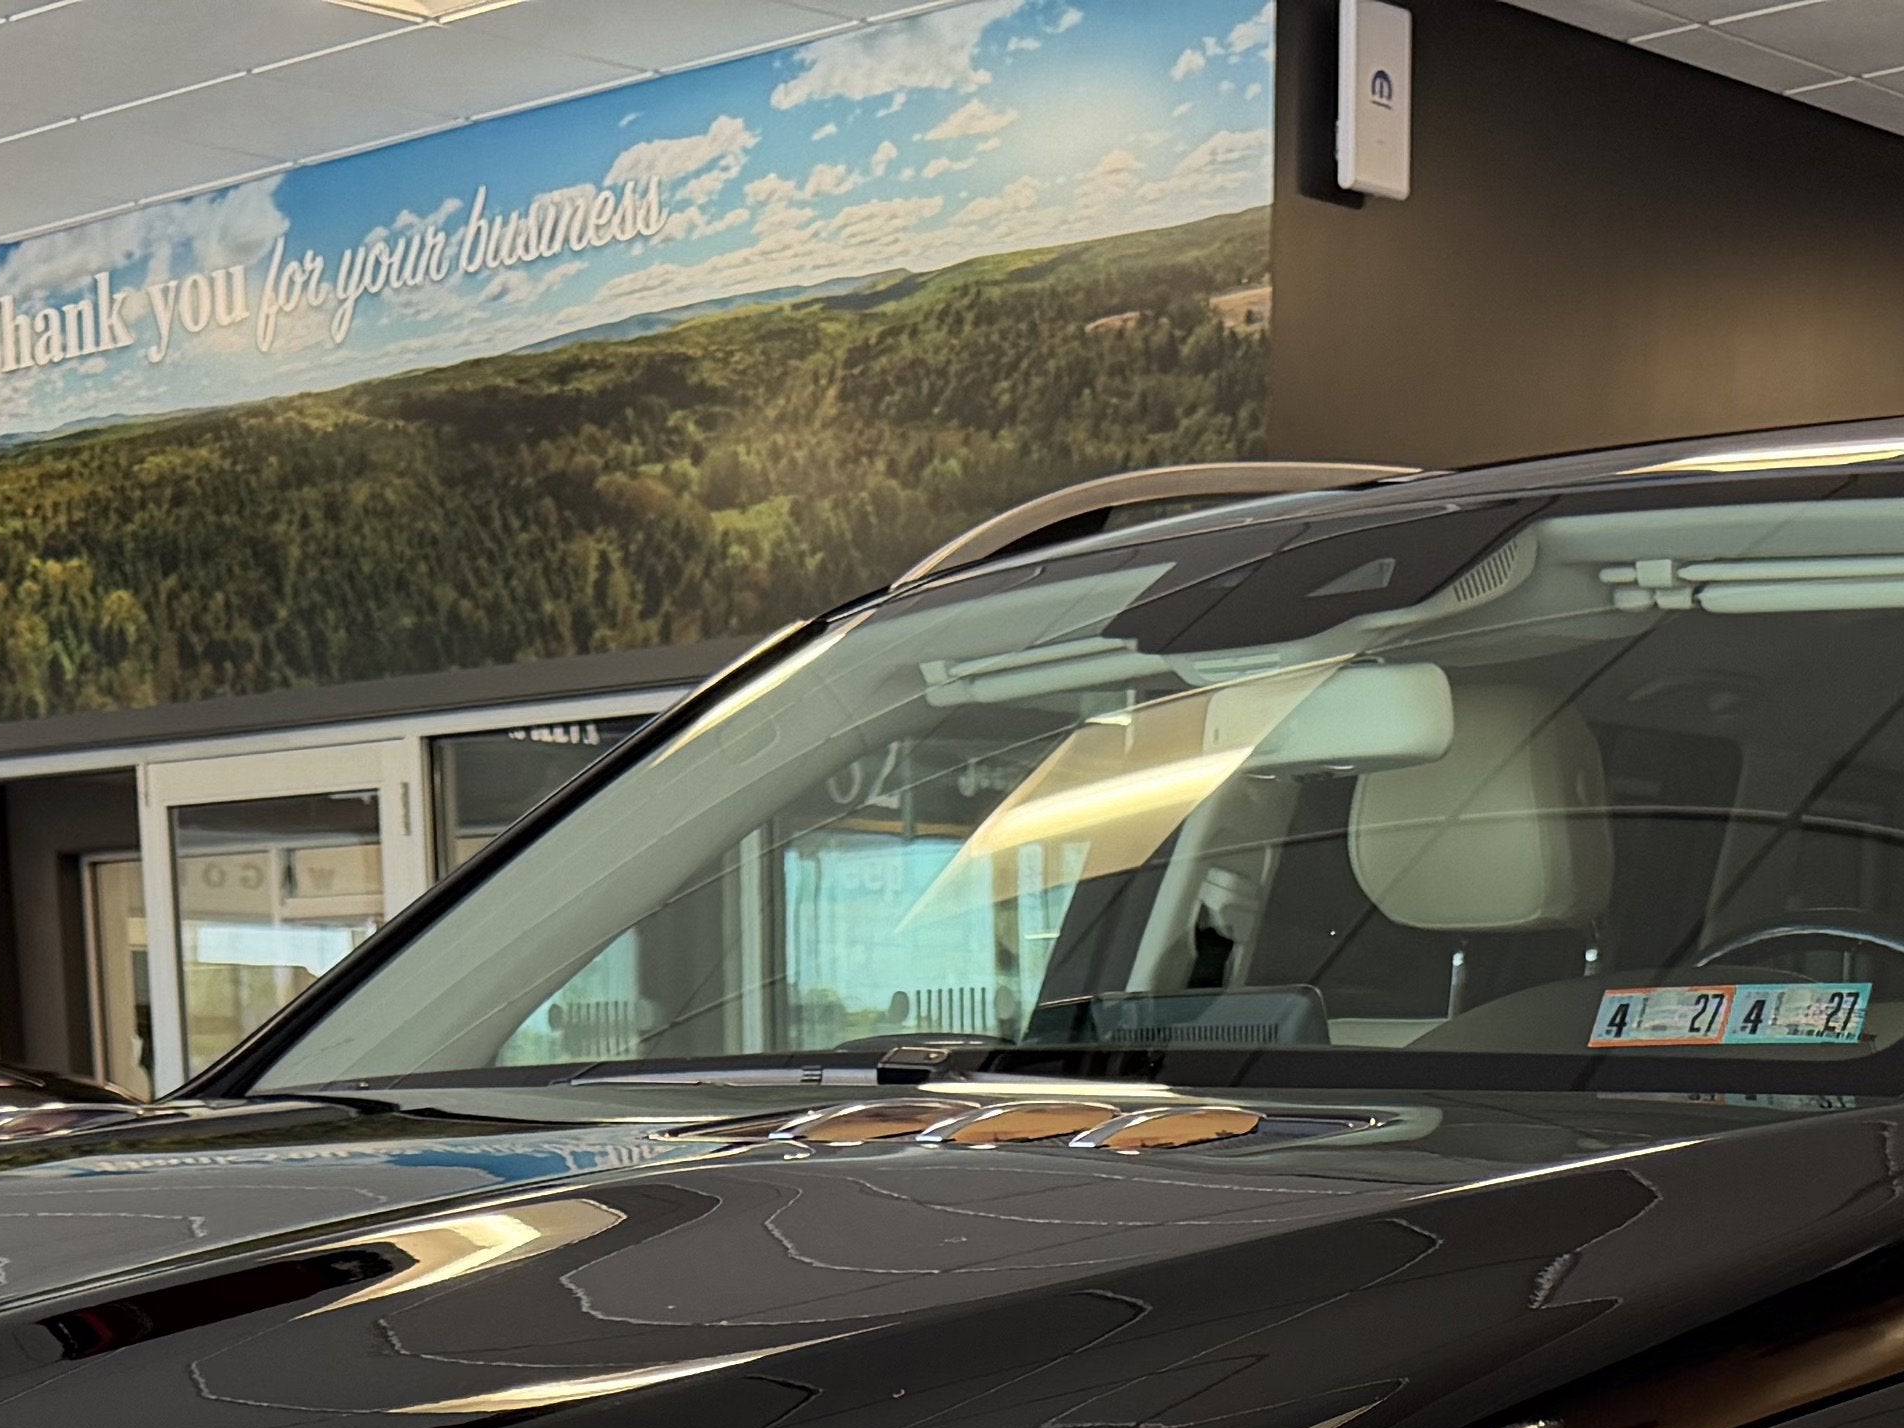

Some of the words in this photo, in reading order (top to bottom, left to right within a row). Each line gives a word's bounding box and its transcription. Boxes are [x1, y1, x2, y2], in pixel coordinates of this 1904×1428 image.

[147, 264, 250, 364] you
[256, 235, 326, 353] for
[331, 224, 449, 344] your
[459, 175, 669, 273] business
[1606, 1002, 1631, 1038] 4
[1688, 993, 1725, 1034] 27
[1741, 998, 1766, 1035] 4
[1823, 991, 1861, 1033] 27
